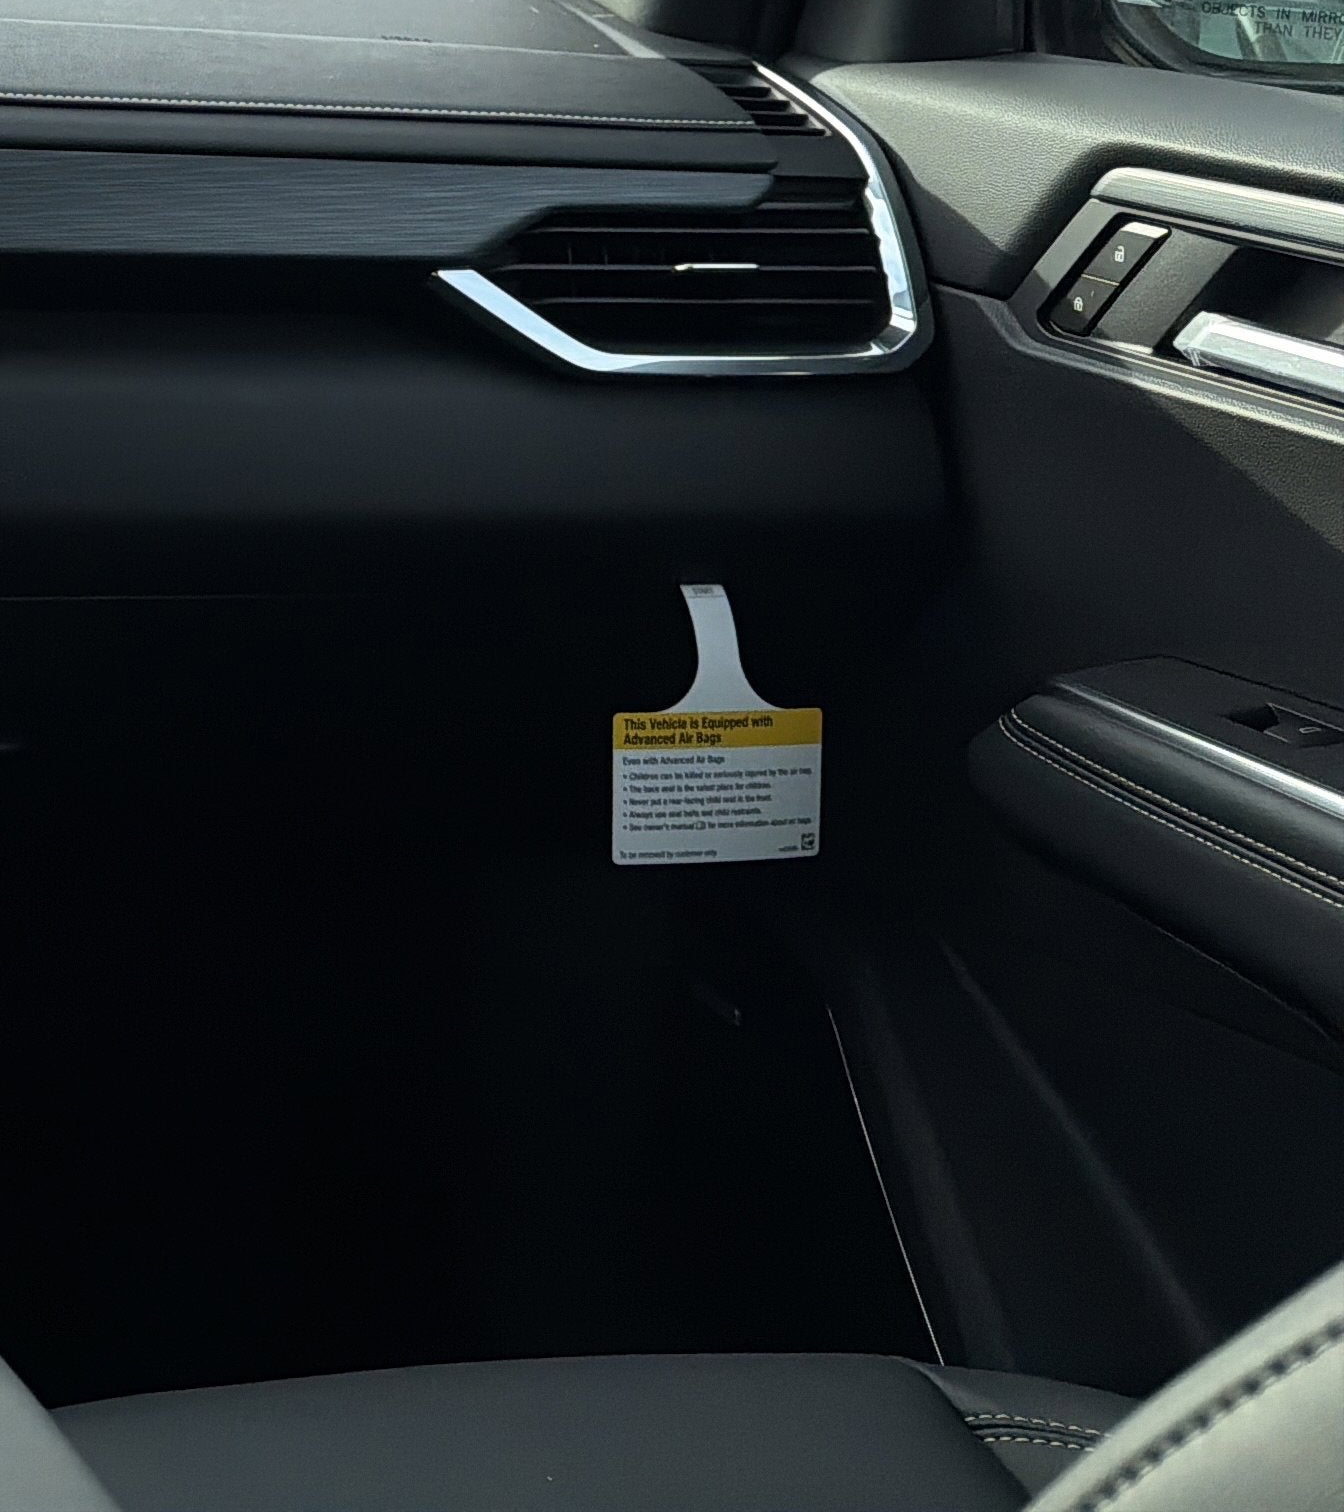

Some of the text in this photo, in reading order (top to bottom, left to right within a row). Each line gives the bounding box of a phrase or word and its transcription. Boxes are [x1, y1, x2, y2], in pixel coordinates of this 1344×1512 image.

[1200, 0, 1344, 25] OBJECTS IN MIRRO
[1254, 21, 1343, 42] THAN THEY
[623, 715, 774, 731] This Vehicle is Equipped with
[623, 731, 722, 746] Advanced Air Bags
